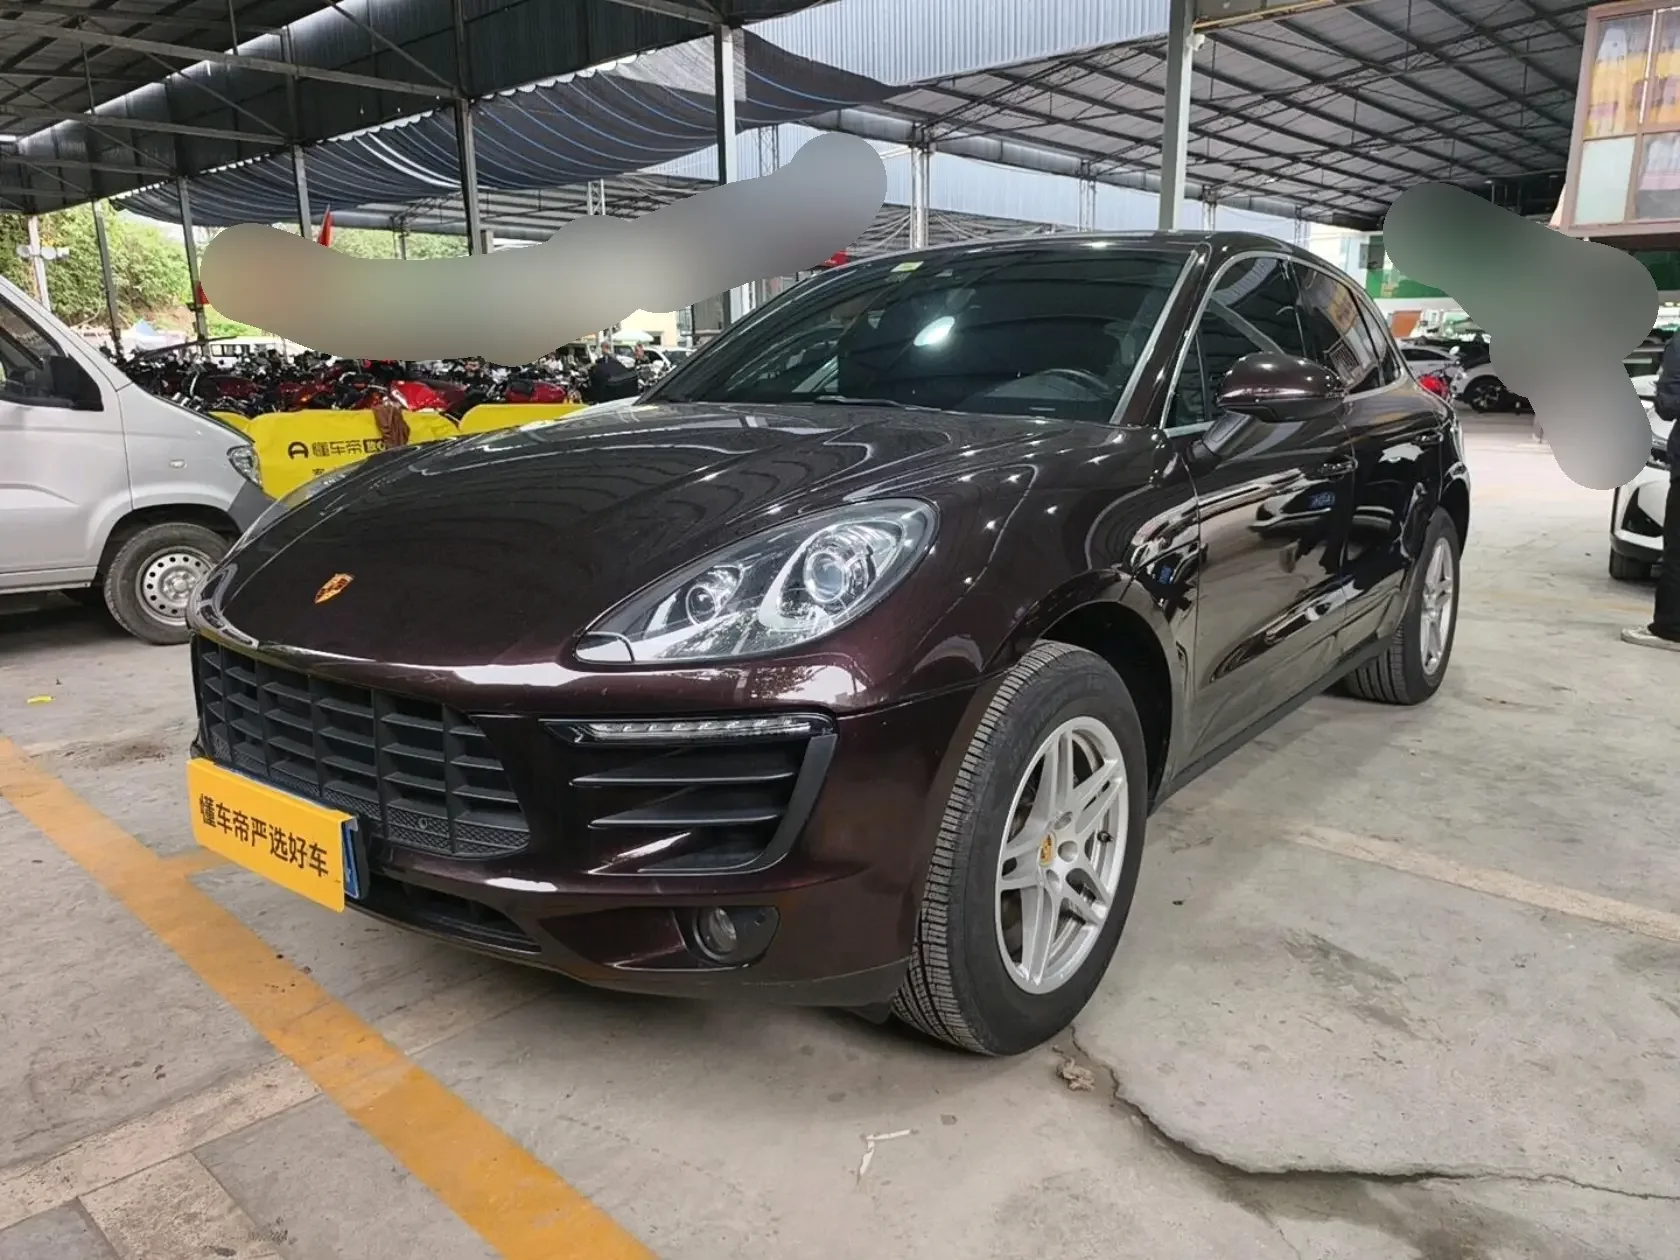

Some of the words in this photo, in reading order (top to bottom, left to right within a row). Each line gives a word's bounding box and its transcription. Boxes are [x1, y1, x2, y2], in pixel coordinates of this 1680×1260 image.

[199, 793, 329, 877] 懂车帝严选好车
